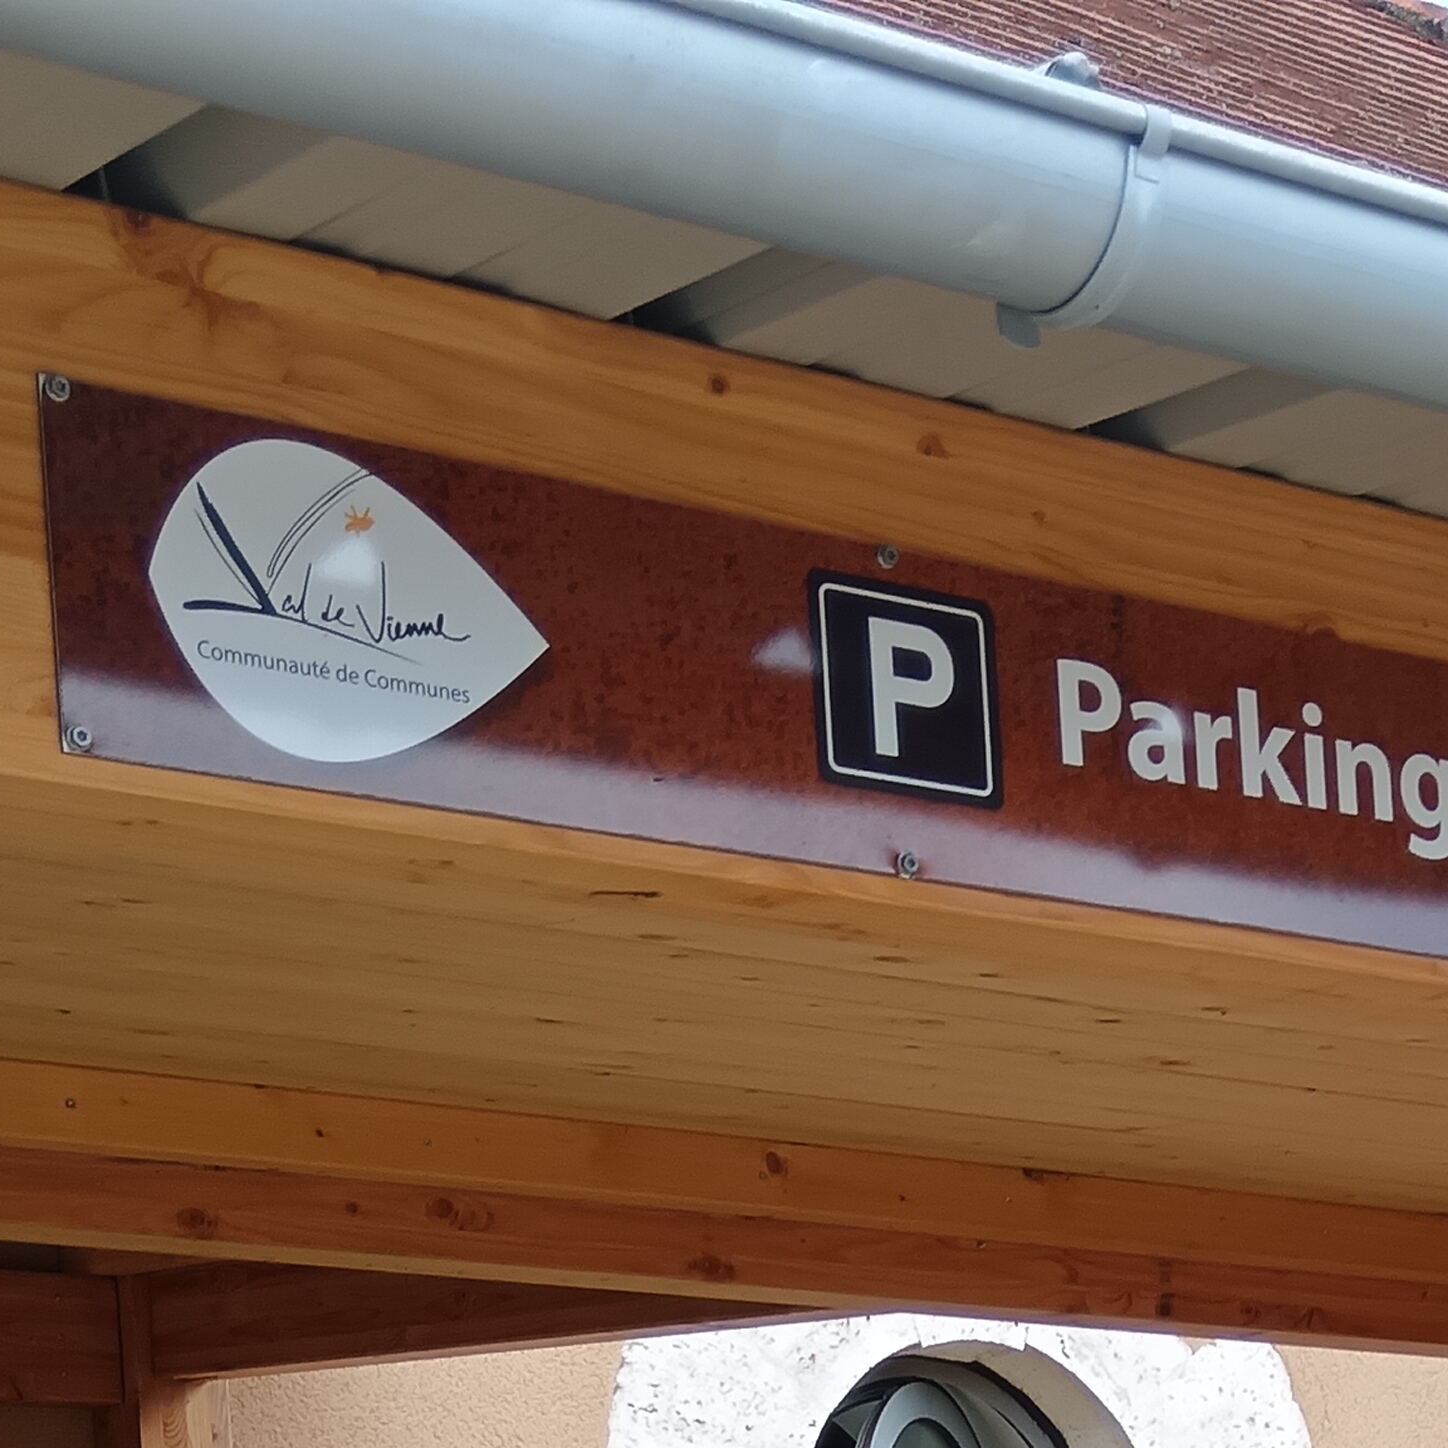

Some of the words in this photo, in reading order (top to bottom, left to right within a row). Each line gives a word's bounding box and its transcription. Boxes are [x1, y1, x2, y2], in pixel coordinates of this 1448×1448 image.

[183, 481, 309, 623] Val
[321, 594, 355, 628] de
[356, 561, 471, 643] Vienne
[197, 640, 330, 681] Communauté
[336, 663, 360, 684] de
[364, 669, 470, 704] Communes
[867, 616, 955, 757] P
